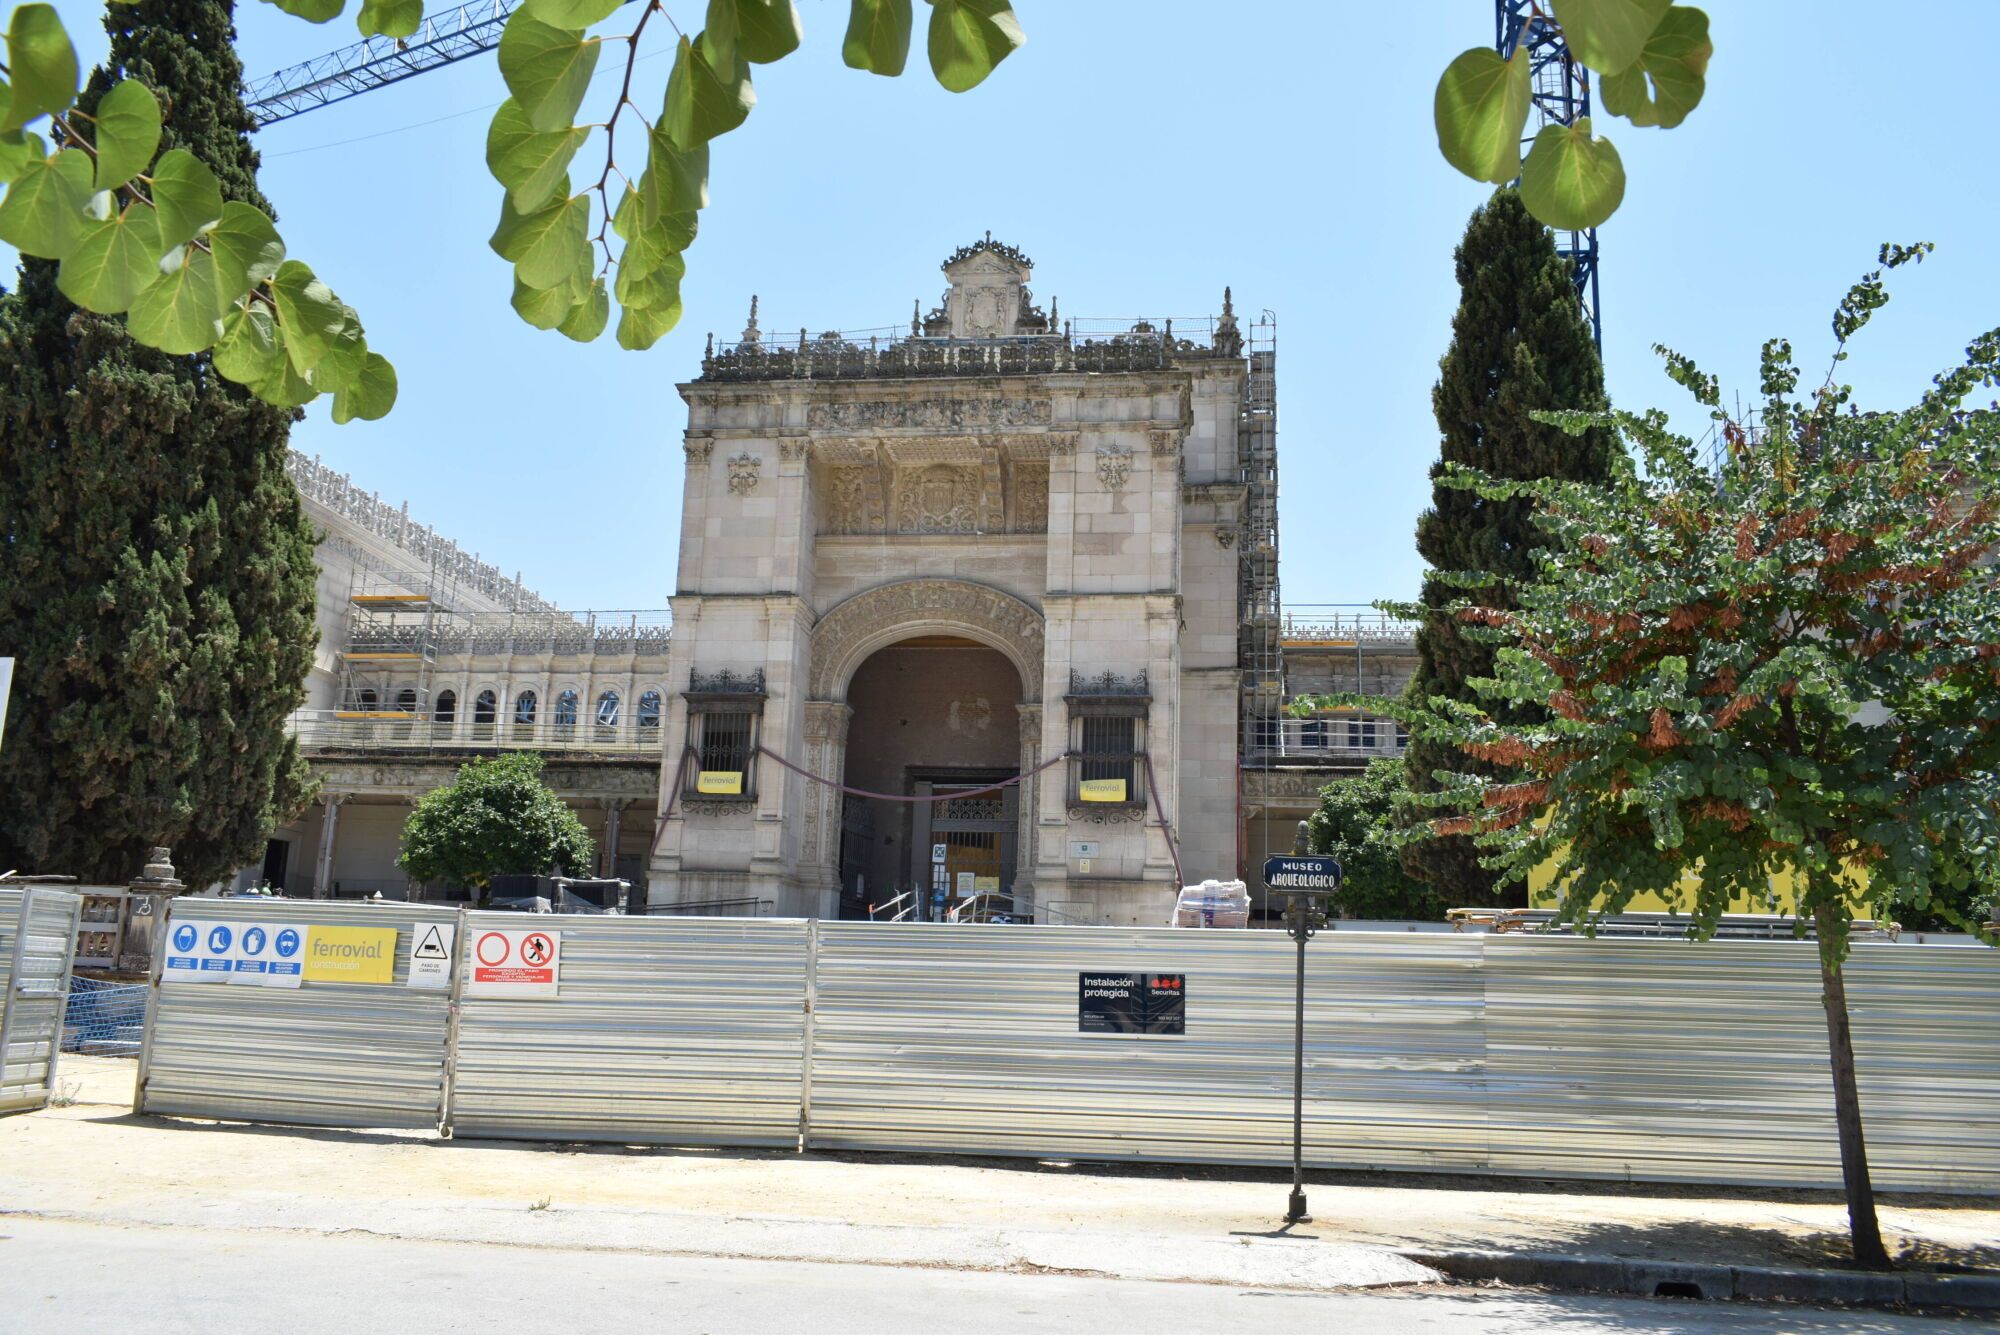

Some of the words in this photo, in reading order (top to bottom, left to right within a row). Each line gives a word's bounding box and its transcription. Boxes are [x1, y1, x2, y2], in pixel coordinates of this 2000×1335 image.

[704, 776, 736, 784] ferrovial
[1086, 783, 1121, 792] ferrovial
[1282, 862, 1323, 872] MUSEO
[1270, 873, 1335, 888] ARQUEOLOGICO
[312, 938, 382, 959] ferrovial
[1084, 977, 1135, 988] Instalación
[1084, 988, 1130, 1000] protegida
[1151, 989, 1180, 997] Securitas
